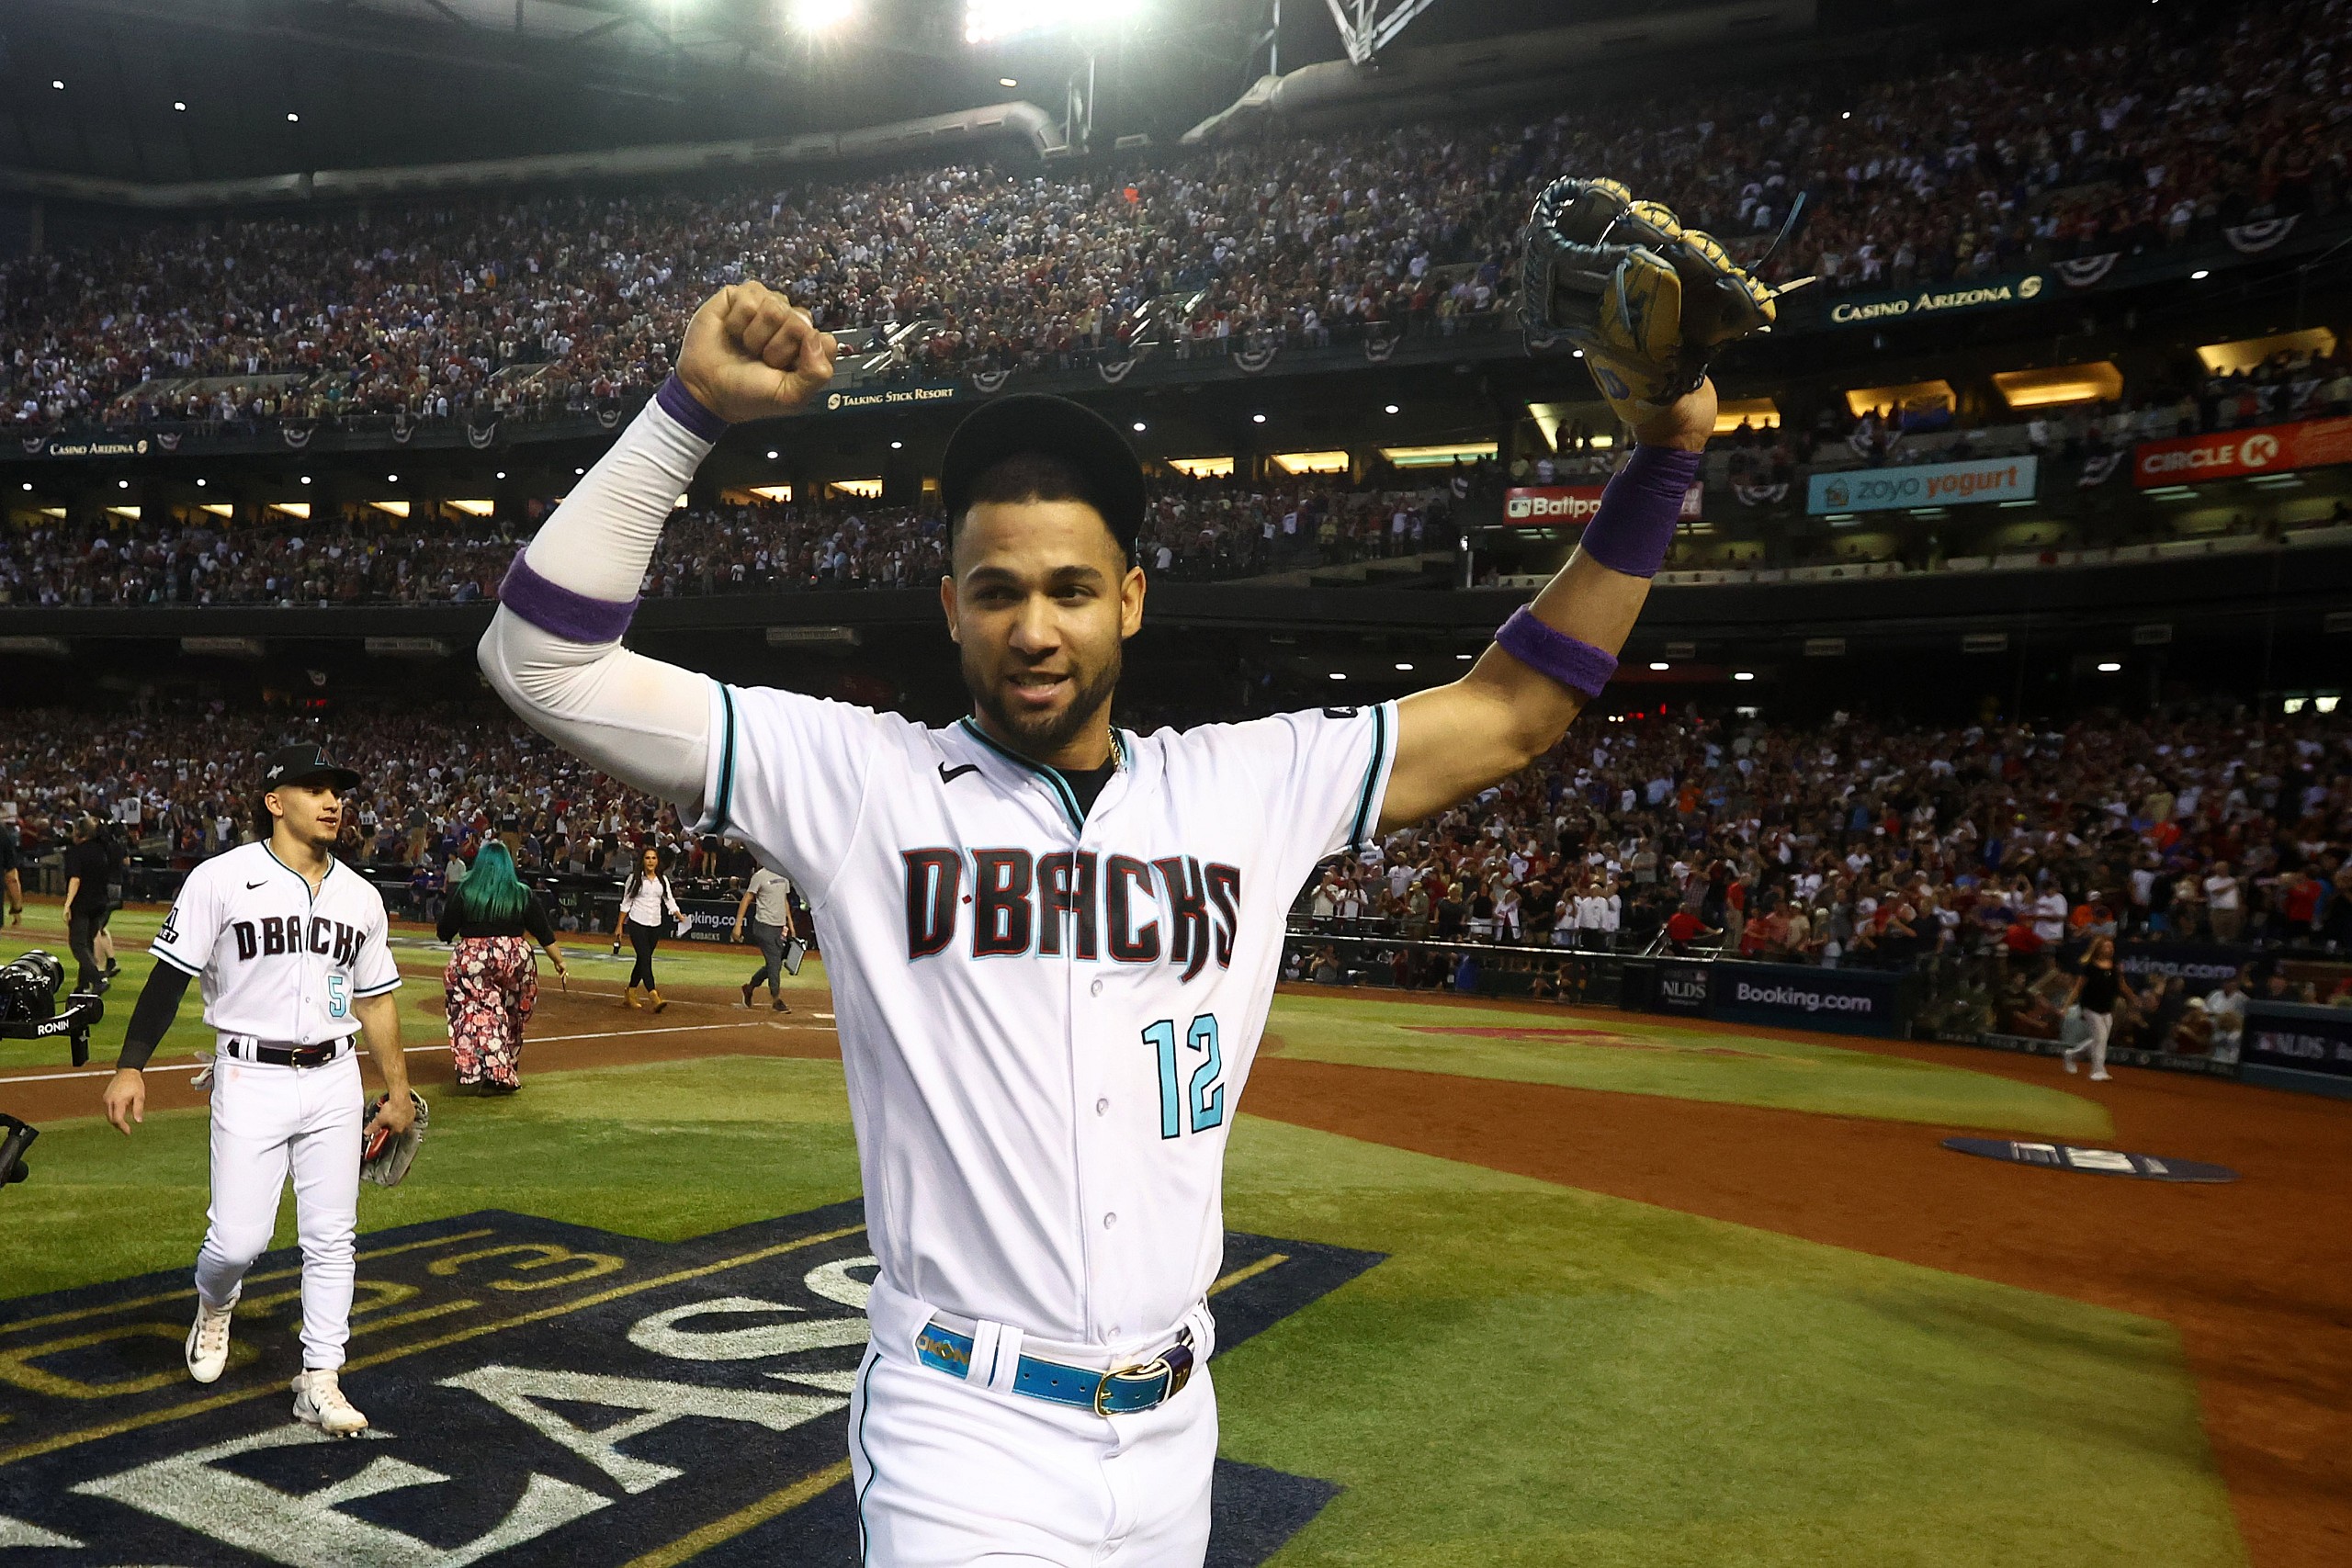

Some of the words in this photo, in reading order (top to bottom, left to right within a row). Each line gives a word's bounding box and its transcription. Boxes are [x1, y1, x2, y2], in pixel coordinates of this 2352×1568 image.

[1831, 299, 1909, 322] CASINO
[1913, 286, 2012, 312] ARIZONA
[842, 394, 883, 406] TALKING
[886, 390, 913, 402] STICK
[915, 388, 954, 399] RESORT
[50, 442, 87, 456] CASINO
[89, 442, 135, 455] ARIZONA
[2143, 445, 2235, 474] CIRCLE
[1857, 477, 1920, 501] zoyo
[1927, 464, 2018, 500] yogurt
[1532, 495, 1602, 518] Ballpa
[328, 975, 346, 1018] 5
[1662, 980, 1707, 998] NLDS
[1737, 982, 1872, 1011] Booking.com
[38, 1019, 70, 1035] RONIN
[1141, 1012, 1226, 1140] 12
